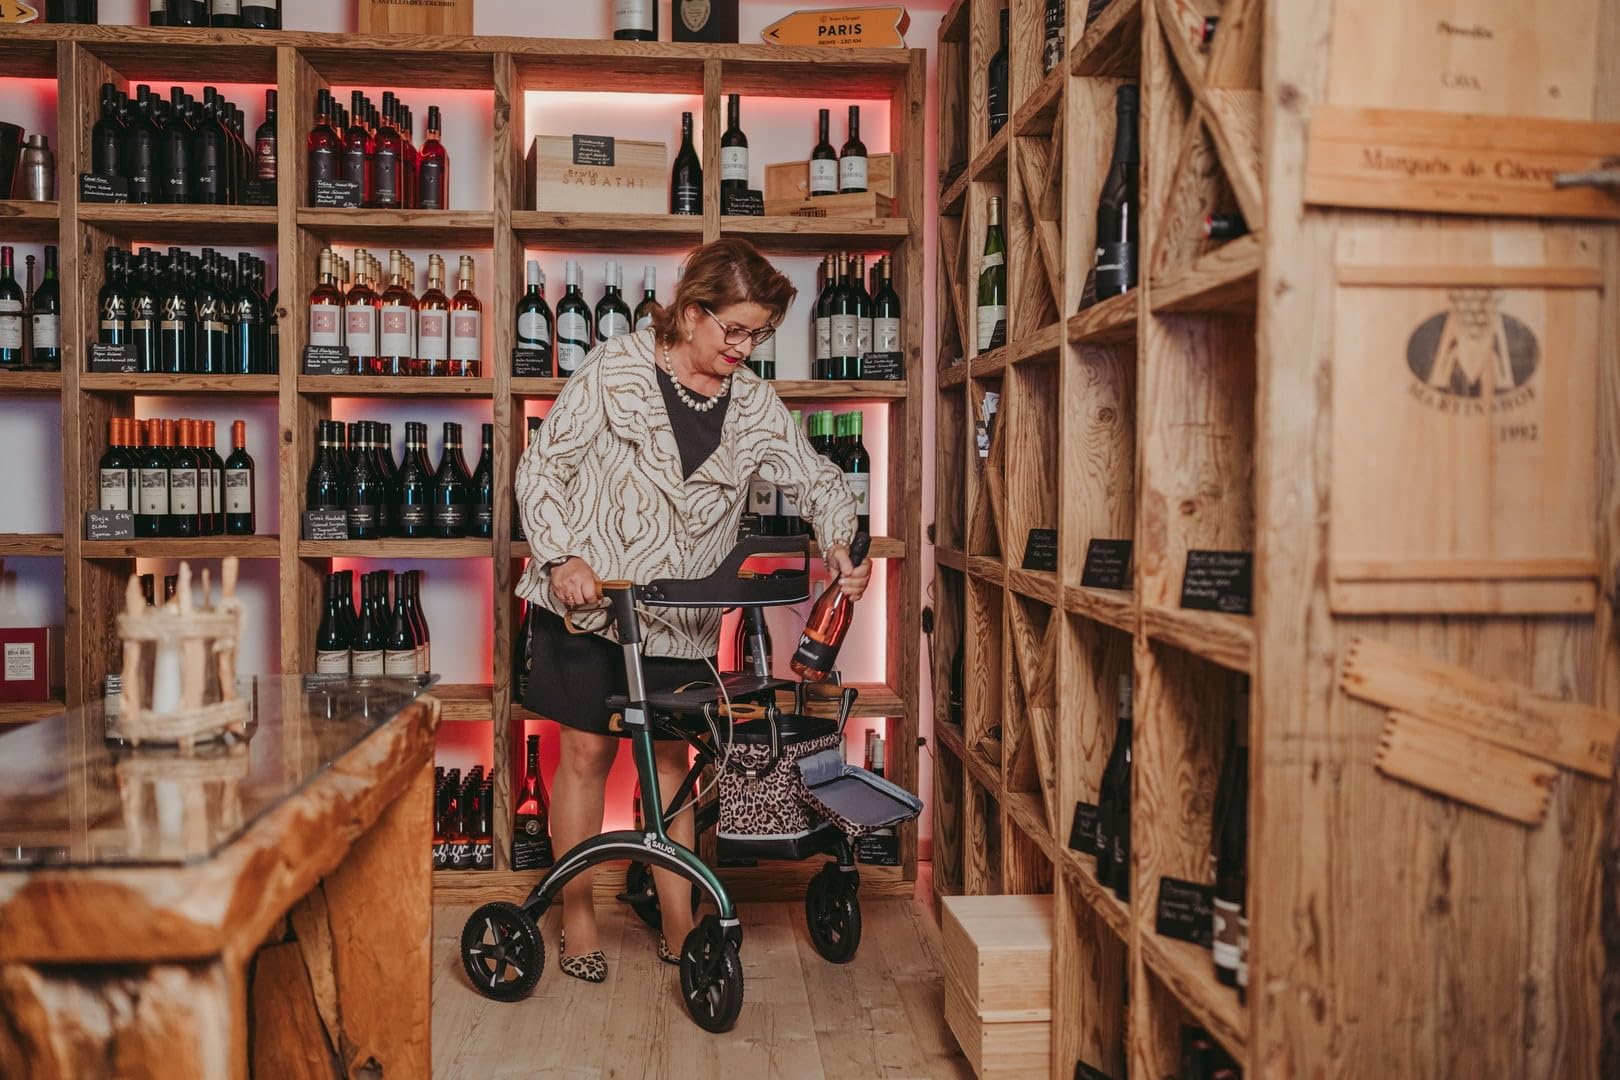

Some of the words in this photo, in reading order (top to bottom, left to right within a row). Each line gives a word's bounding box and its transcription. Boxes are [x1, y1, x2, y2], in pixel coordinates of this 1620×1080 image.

[818, 23, 862, 37] PARIS
[562, 175, 644, 188] SABATHI
[90, 514, 110, 524] Rioja
